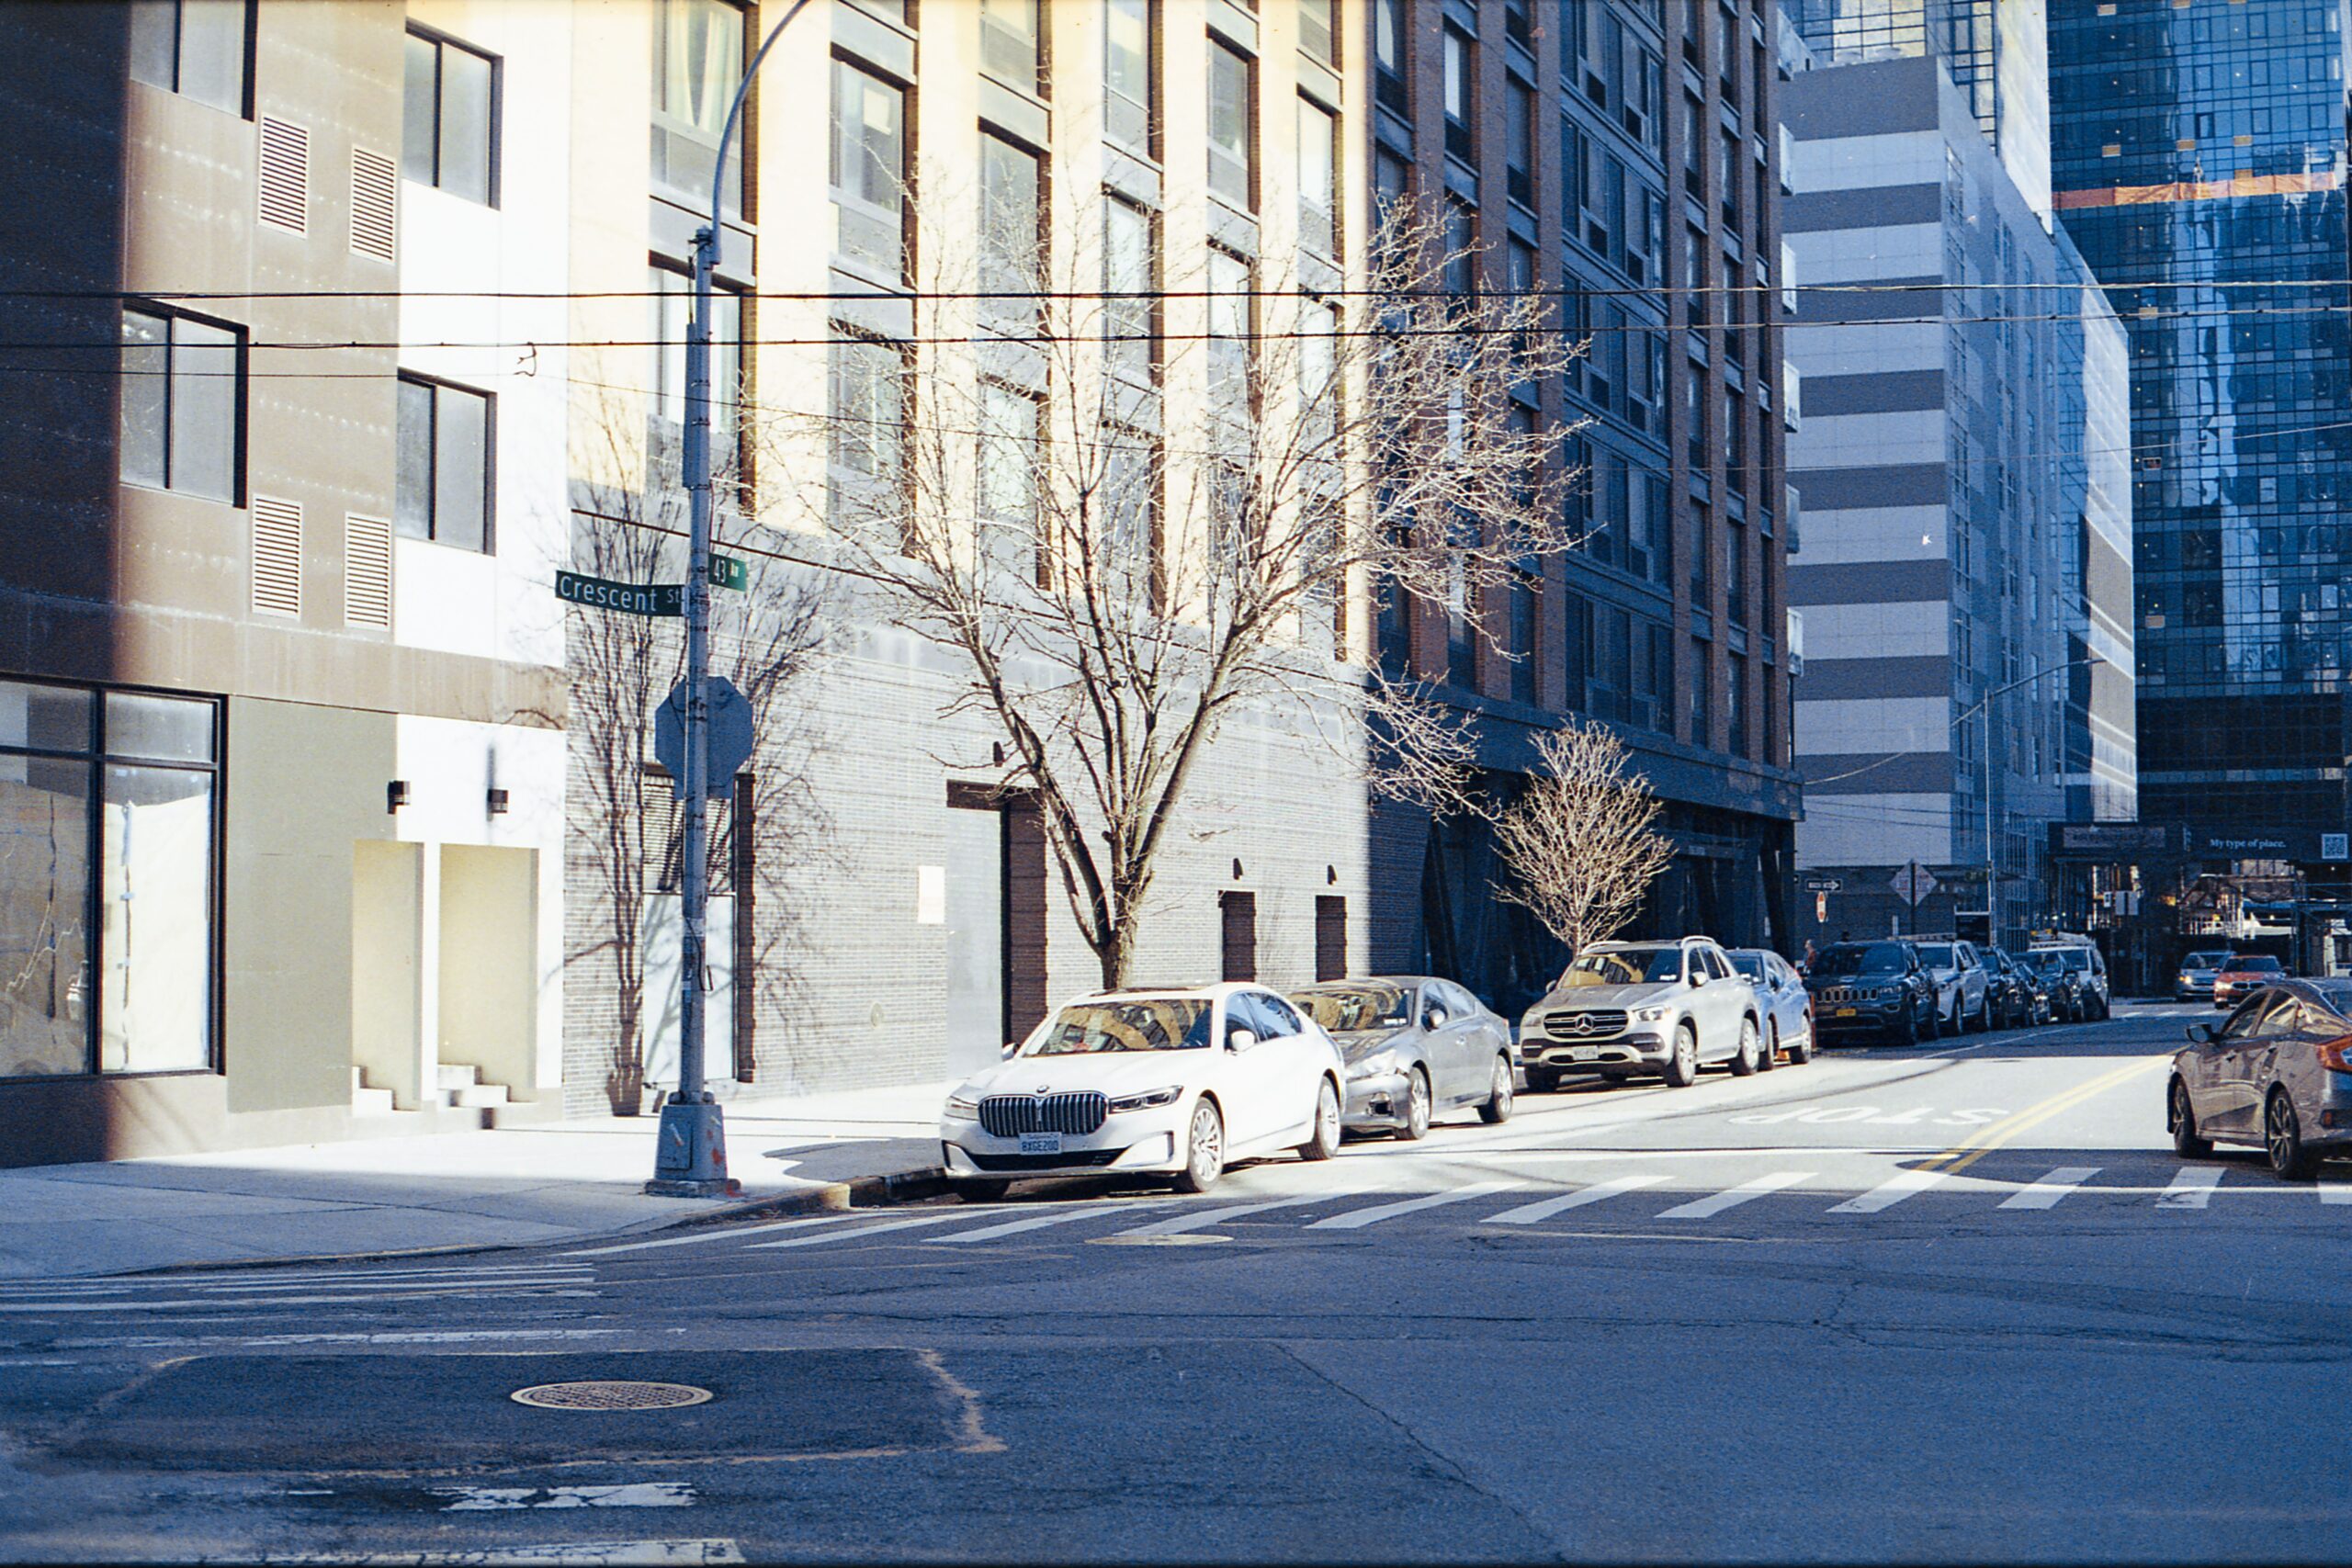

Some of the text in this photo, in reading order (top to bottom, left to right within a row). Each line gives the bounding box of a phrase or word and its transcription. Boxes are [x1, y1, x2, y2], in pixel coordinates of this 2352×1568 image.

[713, 558, 727, 583] 43
[560, 575, 681, 612] Crescent St
[2210, 838, 2286, 851] My type of place.
[1727, 1105, 2010, 1125] STOP
